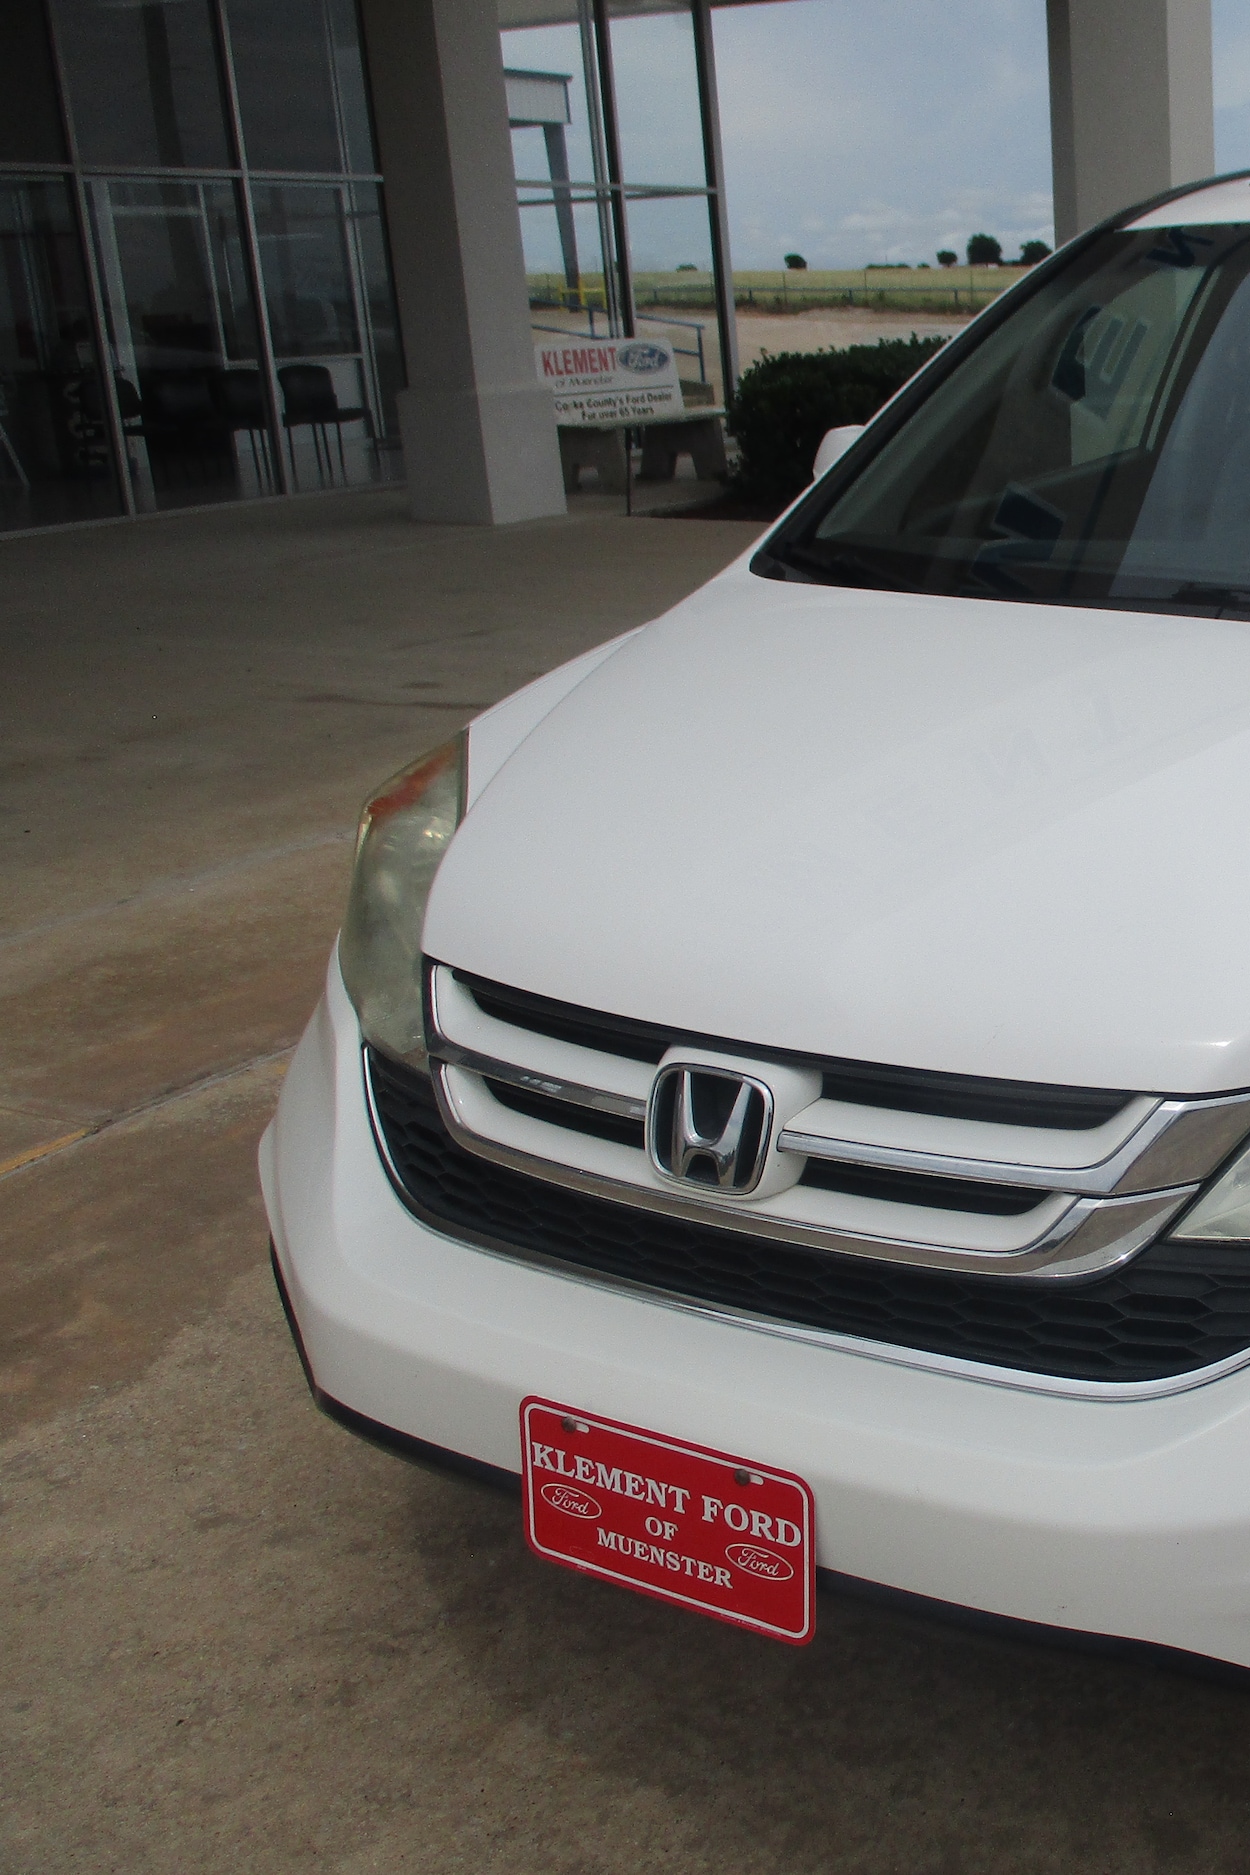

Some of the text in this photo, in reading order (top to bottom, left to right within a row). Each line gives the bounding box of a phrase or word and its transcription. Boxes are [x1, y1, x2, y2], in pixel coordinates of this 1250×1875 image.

[541, 347, 618, 377] KLEMENT
[625, 348, 661, 370] Ford
[531, 1441, 803, 1548] KLEMENT FORD
[550, 1483, 590, 1516] Ford
[644, 1516, 679, 1542] OF
[596, 1527, 734, 1590] MUENSTER
[736, 1548, 780, 1577] Ford
